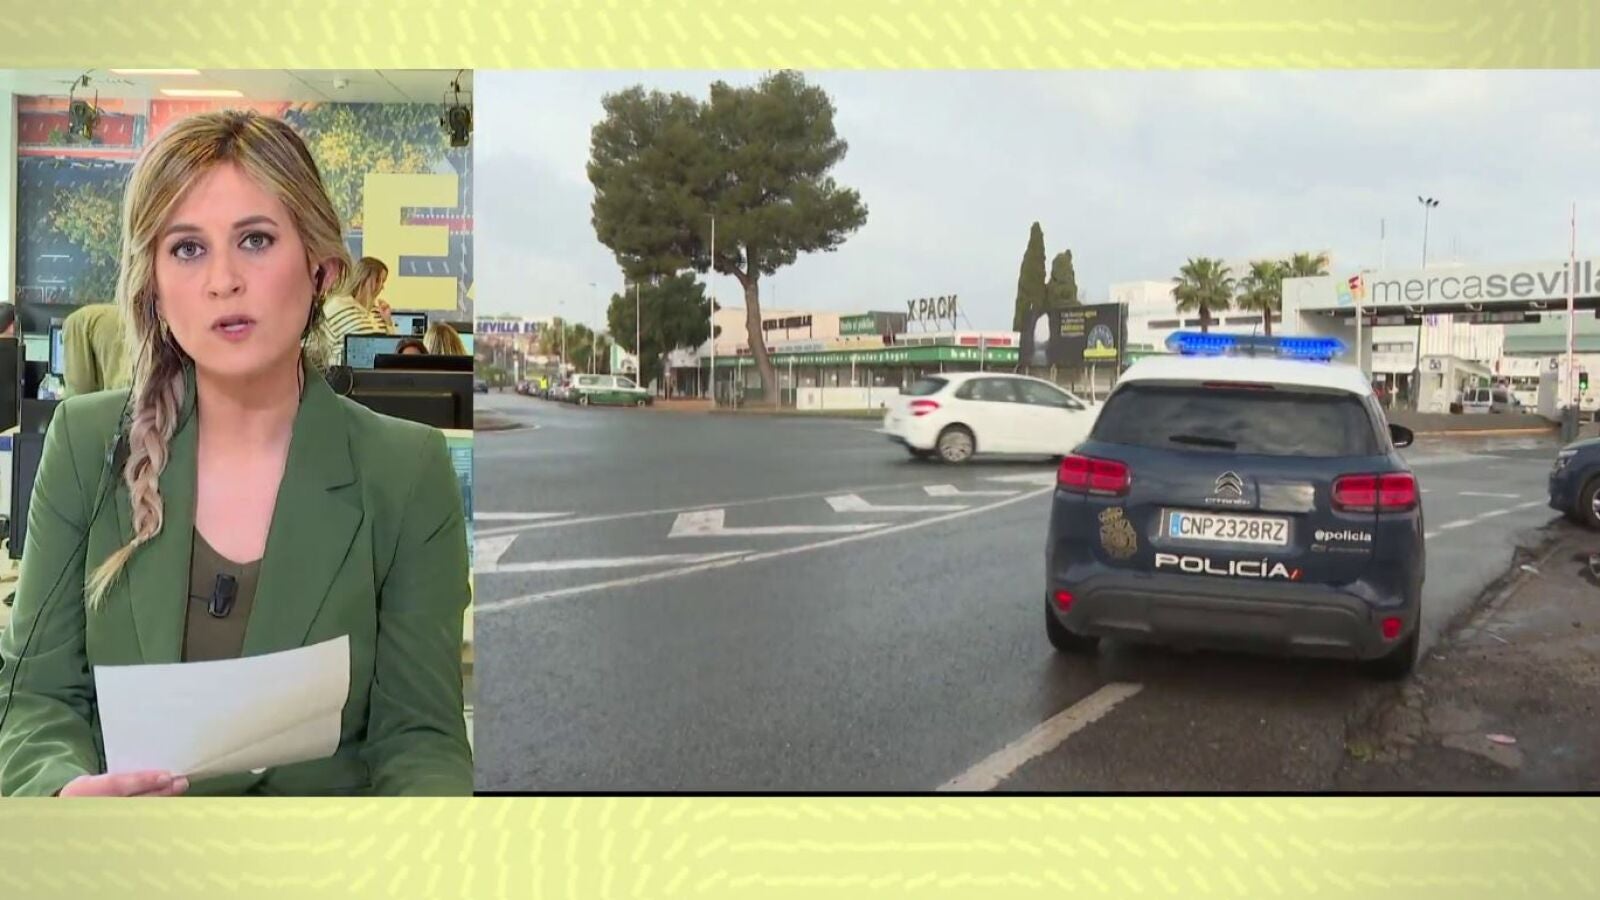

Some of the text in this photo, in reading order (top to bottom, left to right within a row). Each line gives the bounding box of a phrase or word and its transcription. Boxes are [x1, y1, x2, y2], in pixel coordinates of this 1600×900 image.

[477, 321, 520, 333] SEVILLA
[1179, 516, 1286, 541] CNP2328RZ
[1155, 552, 1290, 579] POLICÍA
